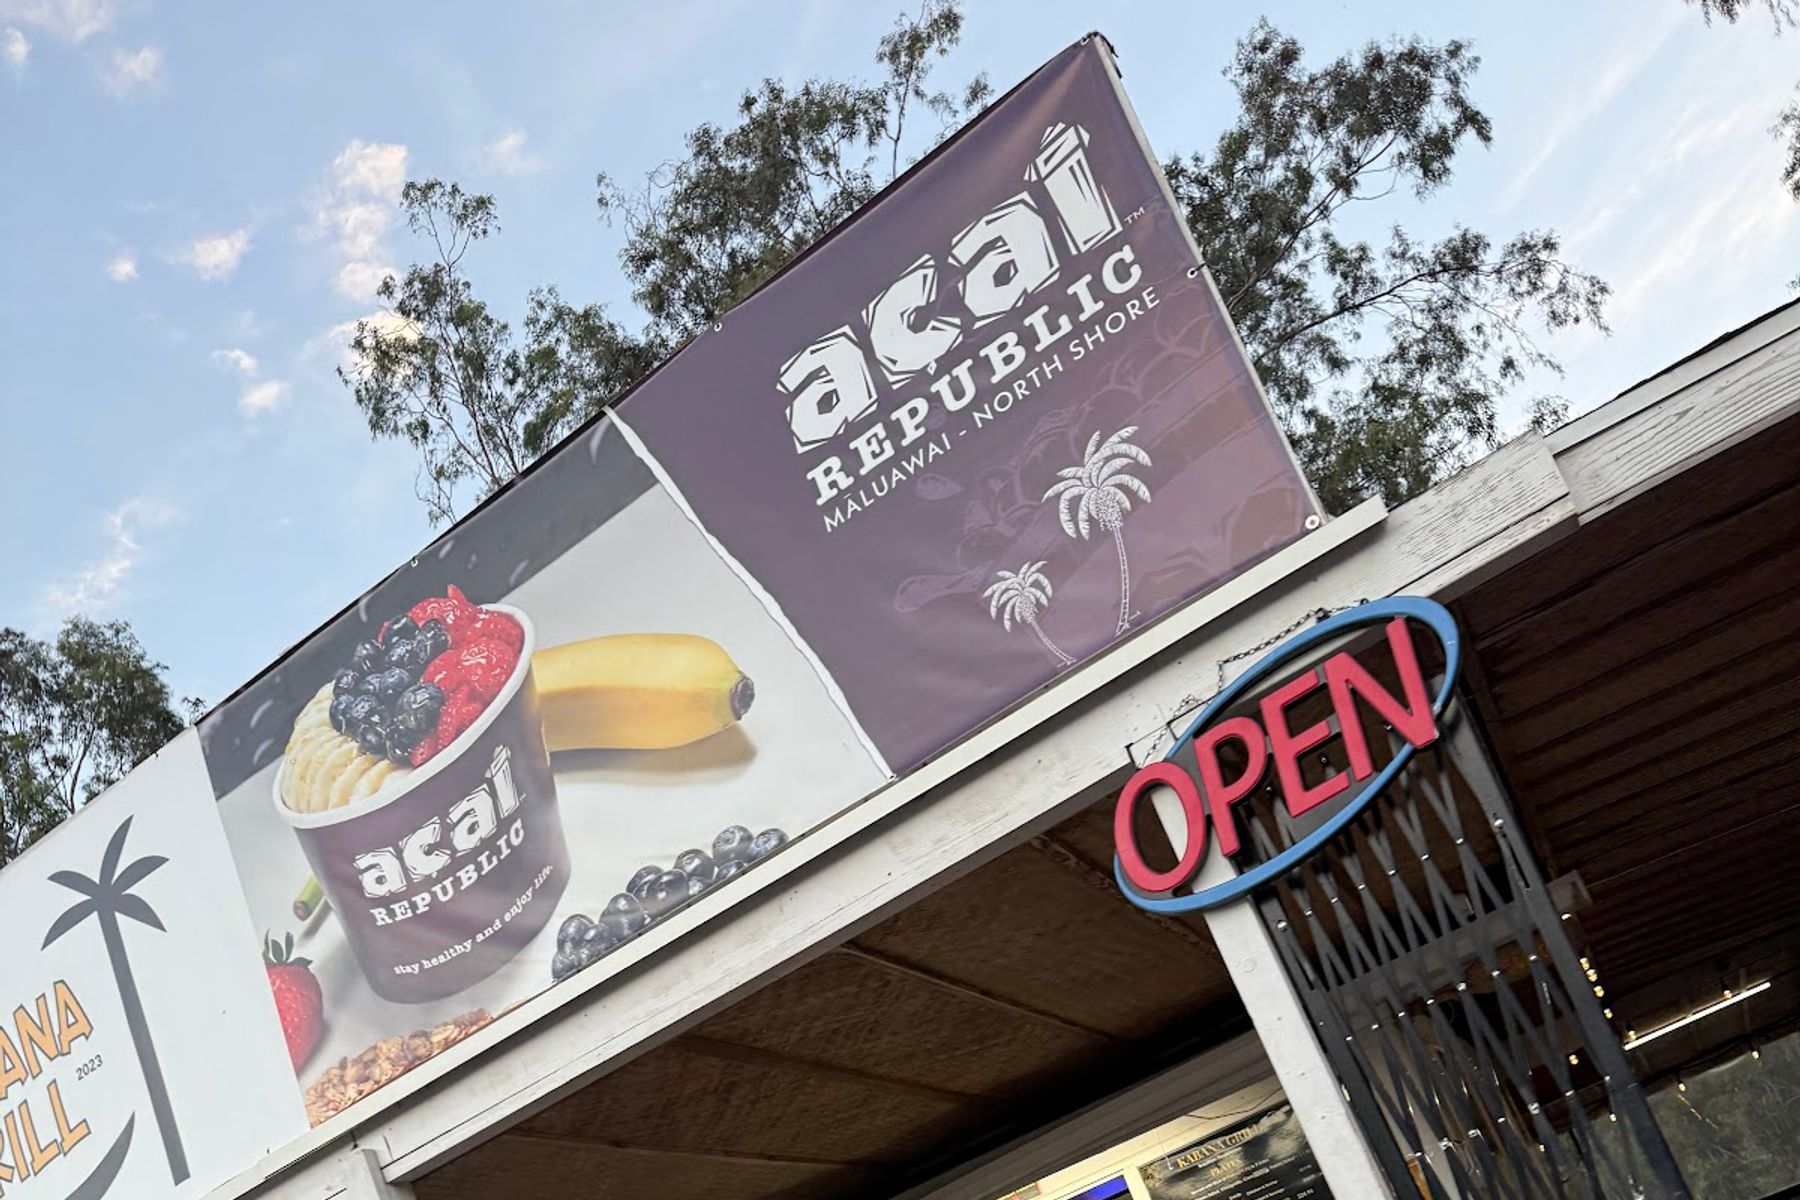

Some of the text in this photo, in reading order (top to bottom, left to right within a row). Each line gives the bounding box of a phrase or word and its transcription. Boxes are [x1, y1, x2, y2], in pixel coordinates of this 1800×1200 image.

[806, 244, 1144, 505] REPUBLIC
[973, 354, 1064, 430] NORTH
[1069, 288, 1160, 361] SHORE
[1114, 617, 1439, 894] OPEN
[369, 818, 525, 926] REPUBLIC
[393, 960, 420, 975] stay
[423, 938, 473, 970] healthy
[475, 918, 502, 943] and
[504, 884, 534, 923] enjoy
[75, 1053, 104, 1081] 2023
